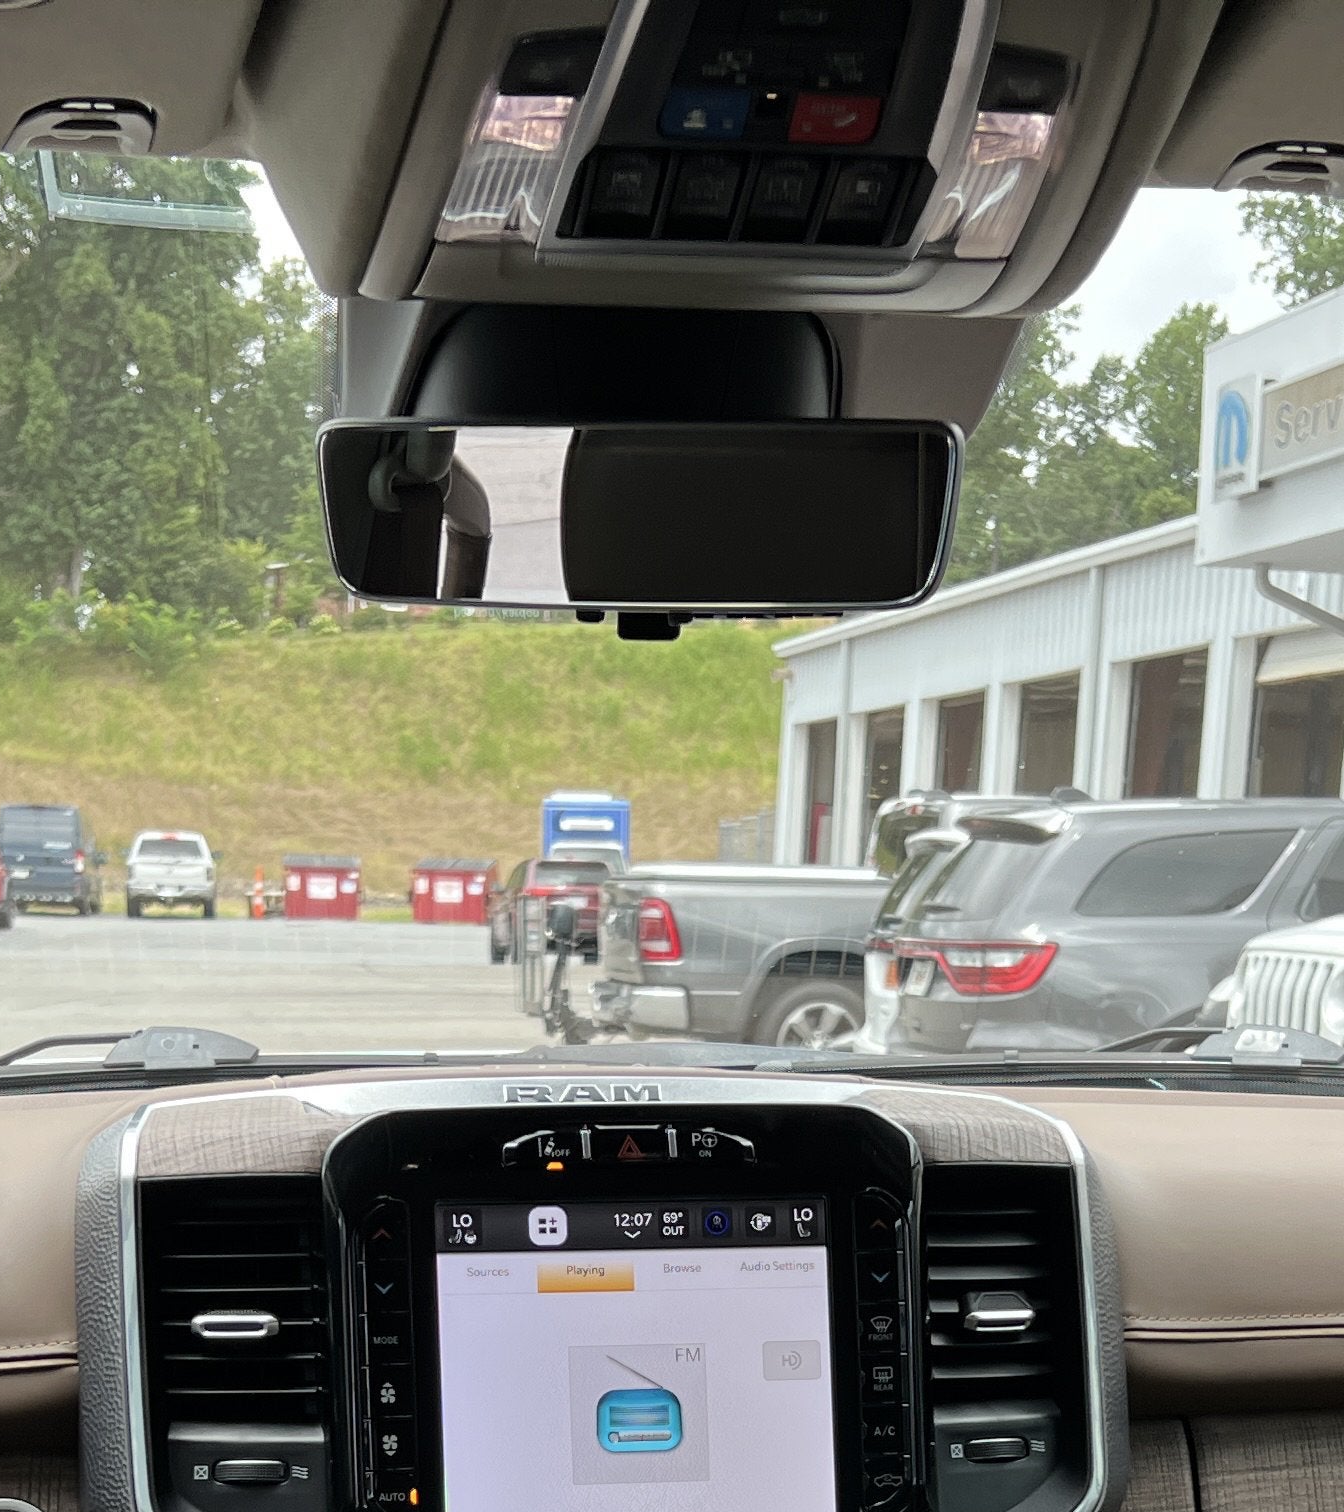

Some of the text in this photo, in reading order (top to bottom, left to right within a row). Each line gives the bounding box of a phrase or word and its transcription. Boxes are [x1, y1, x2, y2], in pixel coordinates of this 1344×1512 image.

[503, 1083, 662, 1102] RAM
[452, 1213, 473, 1228] LO
[613, 1212, 653, 1227] 12:07
[662, 1211, 684, 1224] 69°
[794, 1207, 814, 1222] LO
[662, 1225, 685, 1236] OUT
[466, 1266, 510, 1278] Sources
[566, 1265, 605, 1277] Playing
[663, 1263, 702, 1273] Browse
[740, 1260, 816, 1272] Audio Settings
[373, 1335, 399, 1345] MODE
[868, 1332, 894, 1342] FRONT
[675, 1347, 701, 1363] FM
[873, 1383, 894, 1392] REAR
[874, 1425, 896, 1437] A/C
[378, 1491, 406, 1502] AUTO
